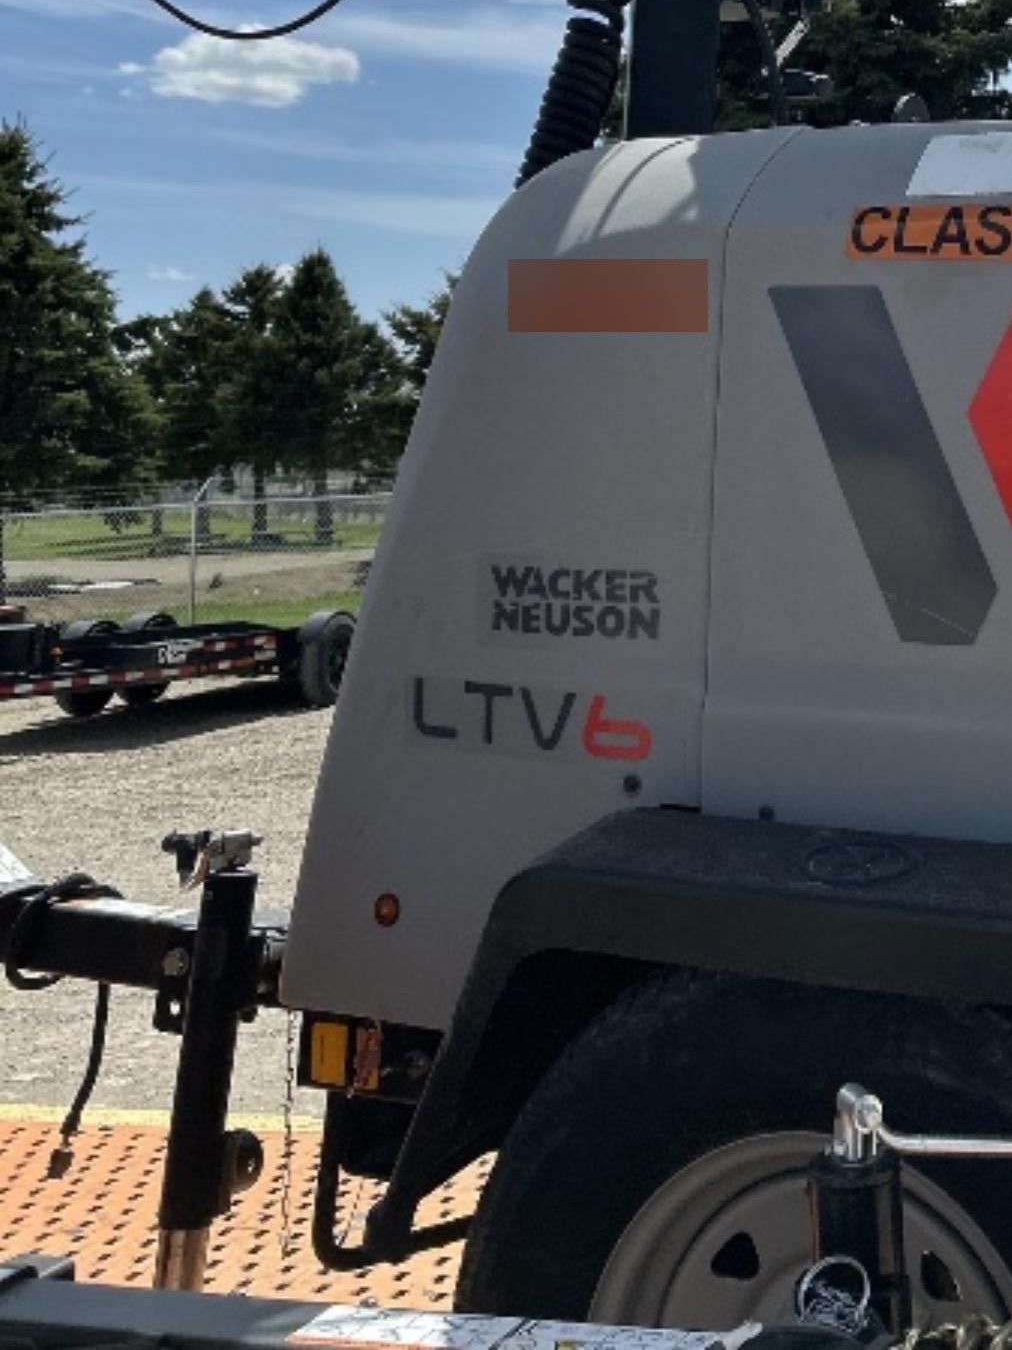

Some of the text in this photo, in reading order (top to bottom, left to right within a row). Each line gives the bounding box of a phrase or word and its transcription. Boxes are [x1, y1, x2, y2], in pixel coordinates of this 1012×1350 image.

[491, 564, 660, 604] WACKER
[491, 600, 660, 640] NEUSON
[413, 676, 653, 762] LTV6
